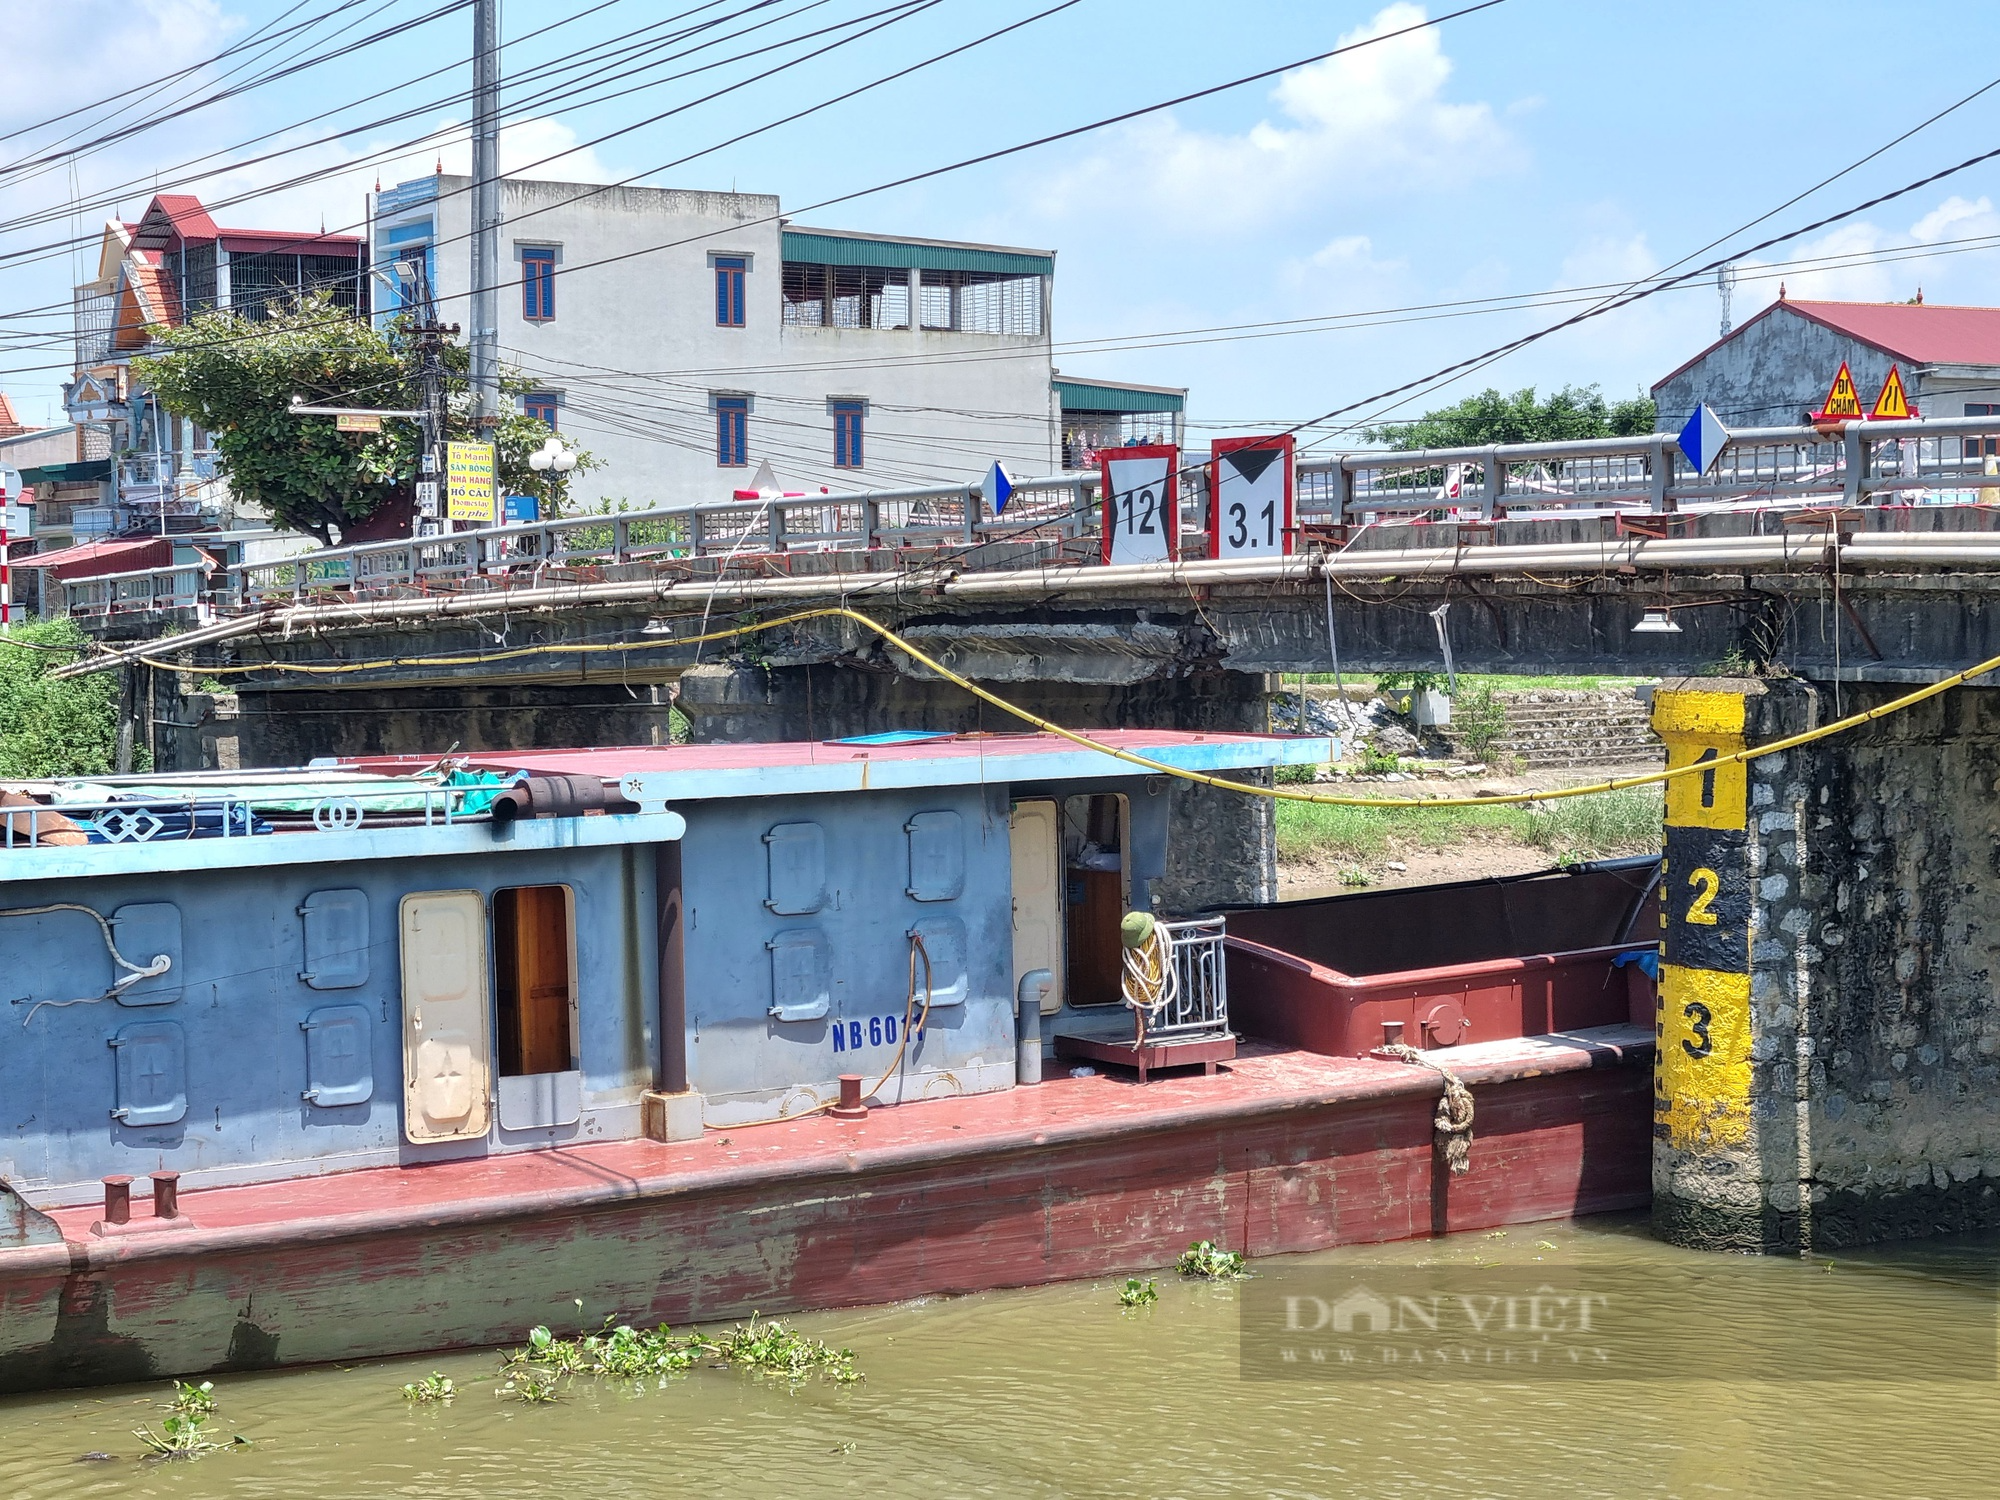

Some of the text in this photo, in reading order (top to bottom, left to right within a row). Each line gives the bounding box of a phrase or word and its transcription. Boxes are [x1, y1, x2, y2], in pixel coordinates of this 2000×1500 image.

[1838, 379, 1848, 394] ĐI
[464, 452, 490, 462] Mạnh
[450, 461, 491, 473] SÂN BÓNG
[450, 474, 491, 485] NHÀ HÀNG
[451, 485, 491, 498] HỒ CÂU
[452, 498, 489, 508] homestay
[452, 508, 489, 518] cà phê
[1122, 489, 1155, 535] 12
[1228, 500, 1274, 549] 3.1
[1695, 747, 1717, 807] 1
[1684, 868, 1719, 925] 2
[1682, 1002, 1713, 1060] 3
